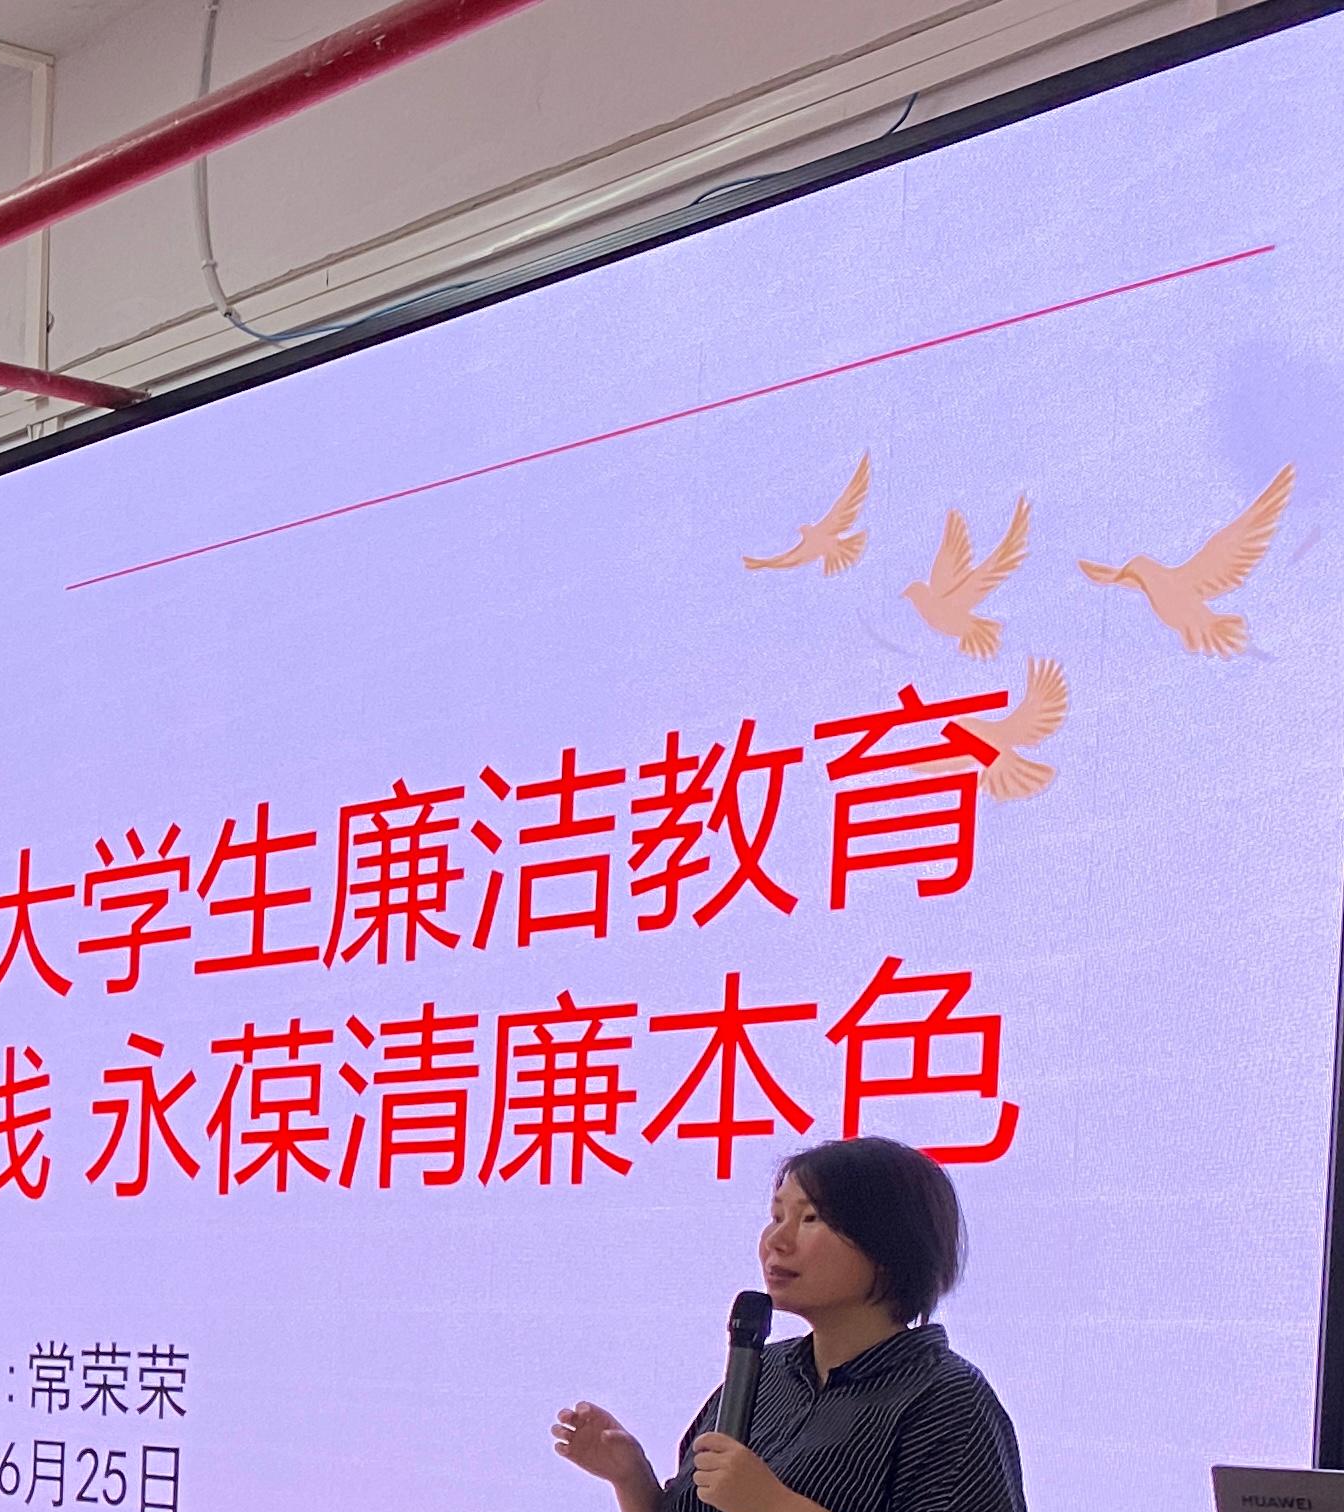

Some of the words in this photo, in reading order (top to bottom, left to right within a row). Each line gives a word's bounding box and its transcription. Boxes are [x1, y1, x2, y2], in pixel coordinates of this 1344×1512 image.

[84, 956, 1021, 1198] 永葆清廉本色
[1241, 1495, 1313, 1511] HUAWEI
